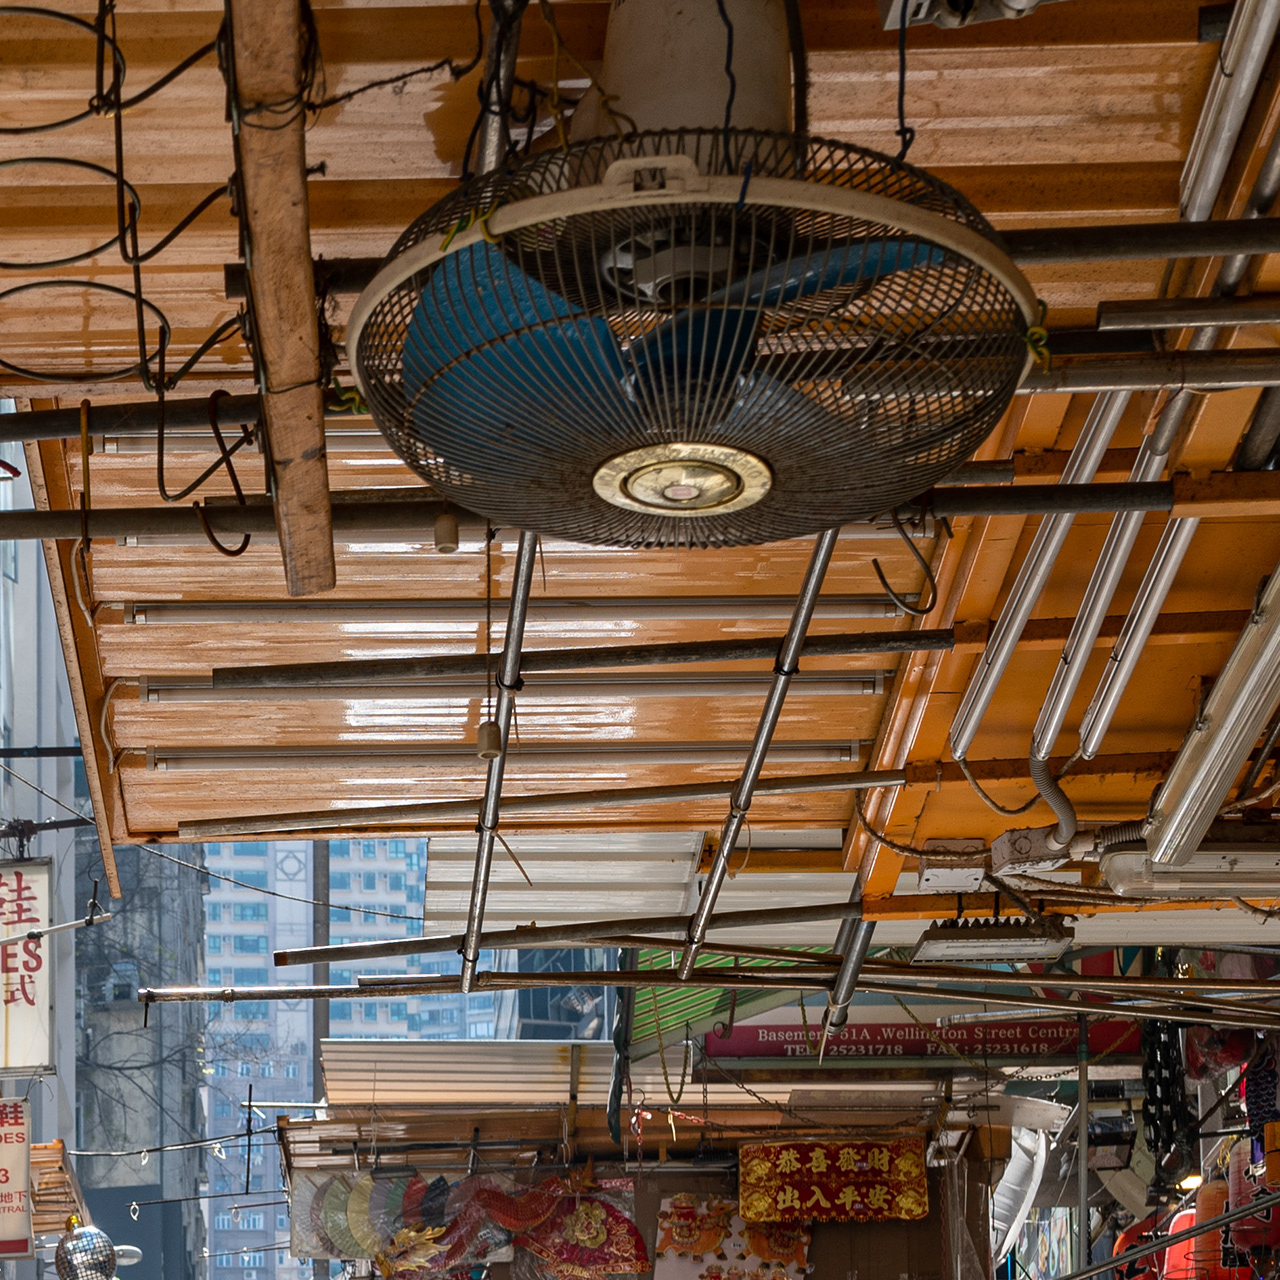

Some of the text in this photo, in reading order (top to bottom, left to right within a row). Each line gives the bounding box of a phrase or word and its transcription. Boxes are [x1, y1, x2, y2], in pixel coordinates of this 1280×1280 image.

[974, 1026, 1022, 1039] Street
[829, 1044, 903, 1057] 25231718
[974, 1043, 1049, 1055] 25231618
[776, 1147, 890, 1174] 恭喜發財
[776, 1183, 892, 1211] 出入平安
